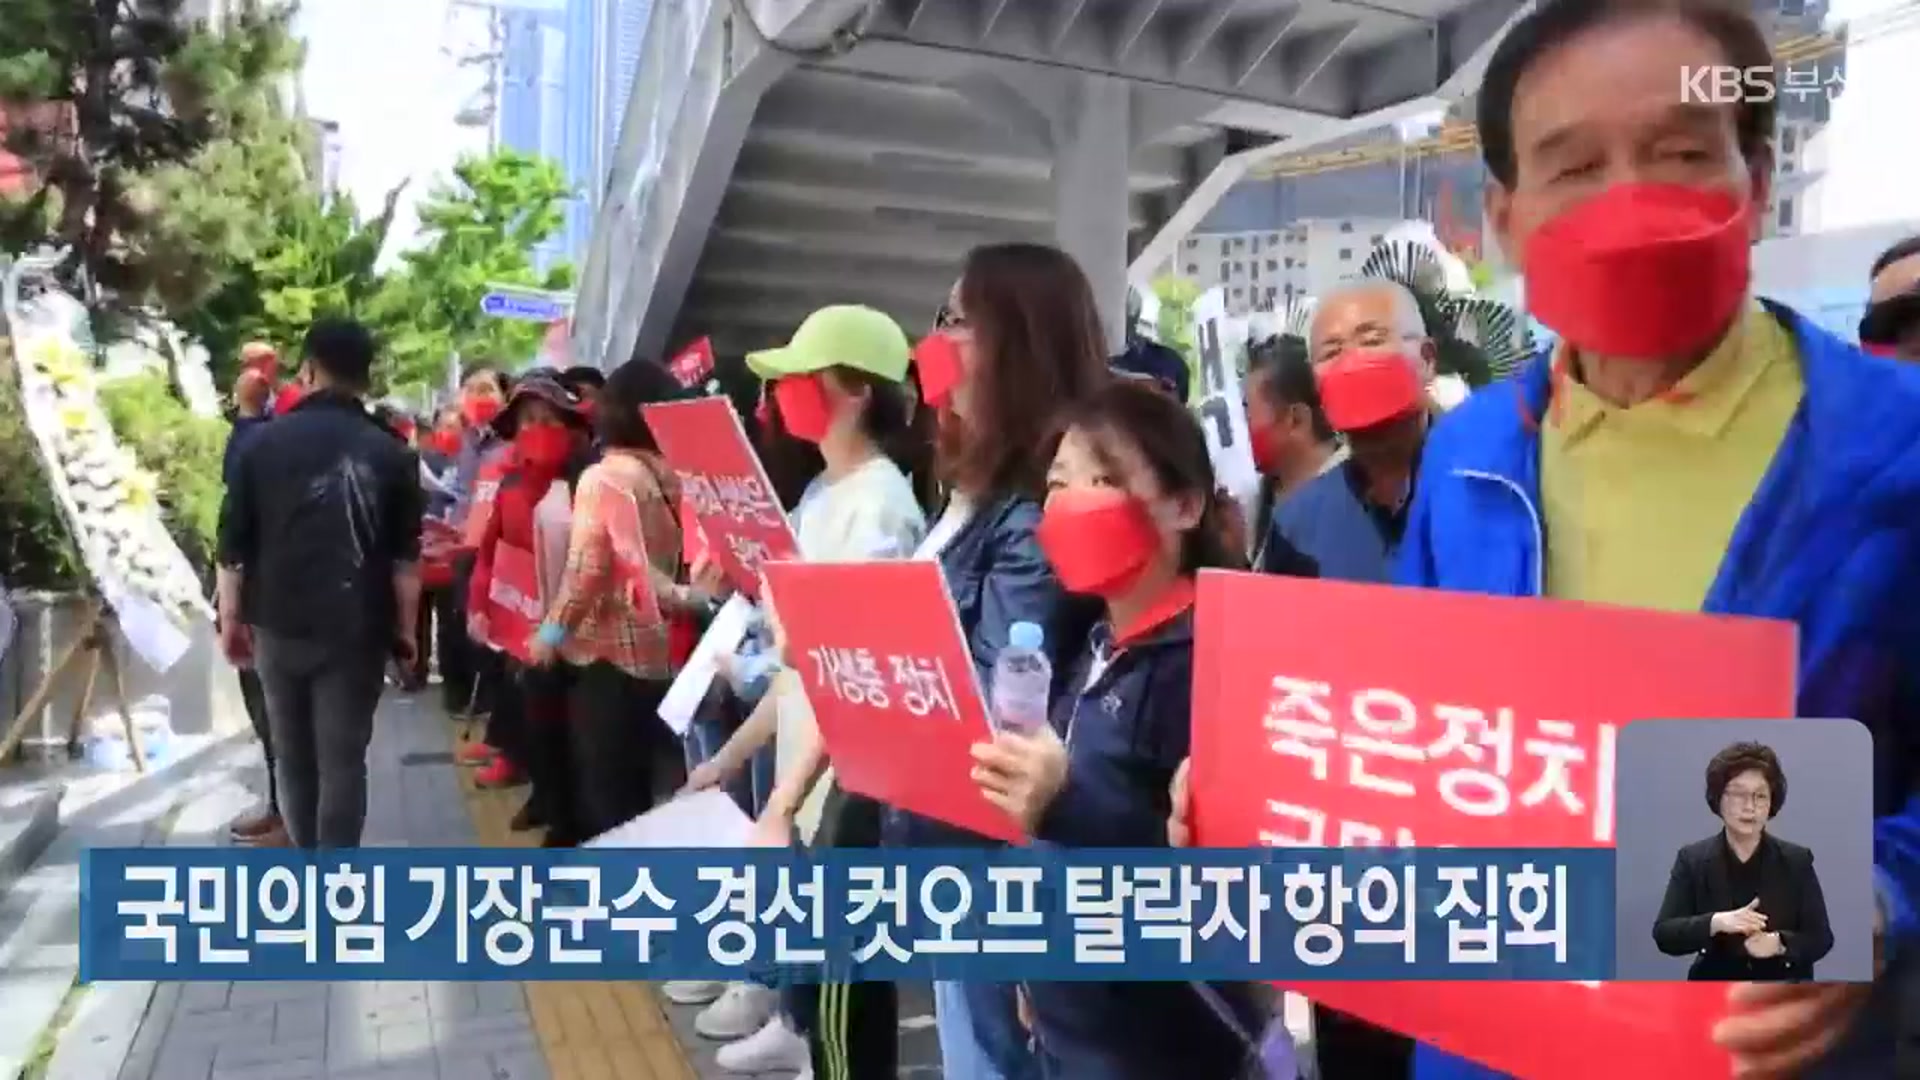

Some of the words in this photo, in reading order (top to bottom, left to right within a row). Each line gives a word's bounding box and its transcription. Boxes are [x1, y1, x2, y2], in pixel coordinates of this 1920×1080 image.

[808, 644, 889, 709] 기생충
[888, 655, 960, 721] 정치
[1263, 674, 1616, 842] 죽은정치
